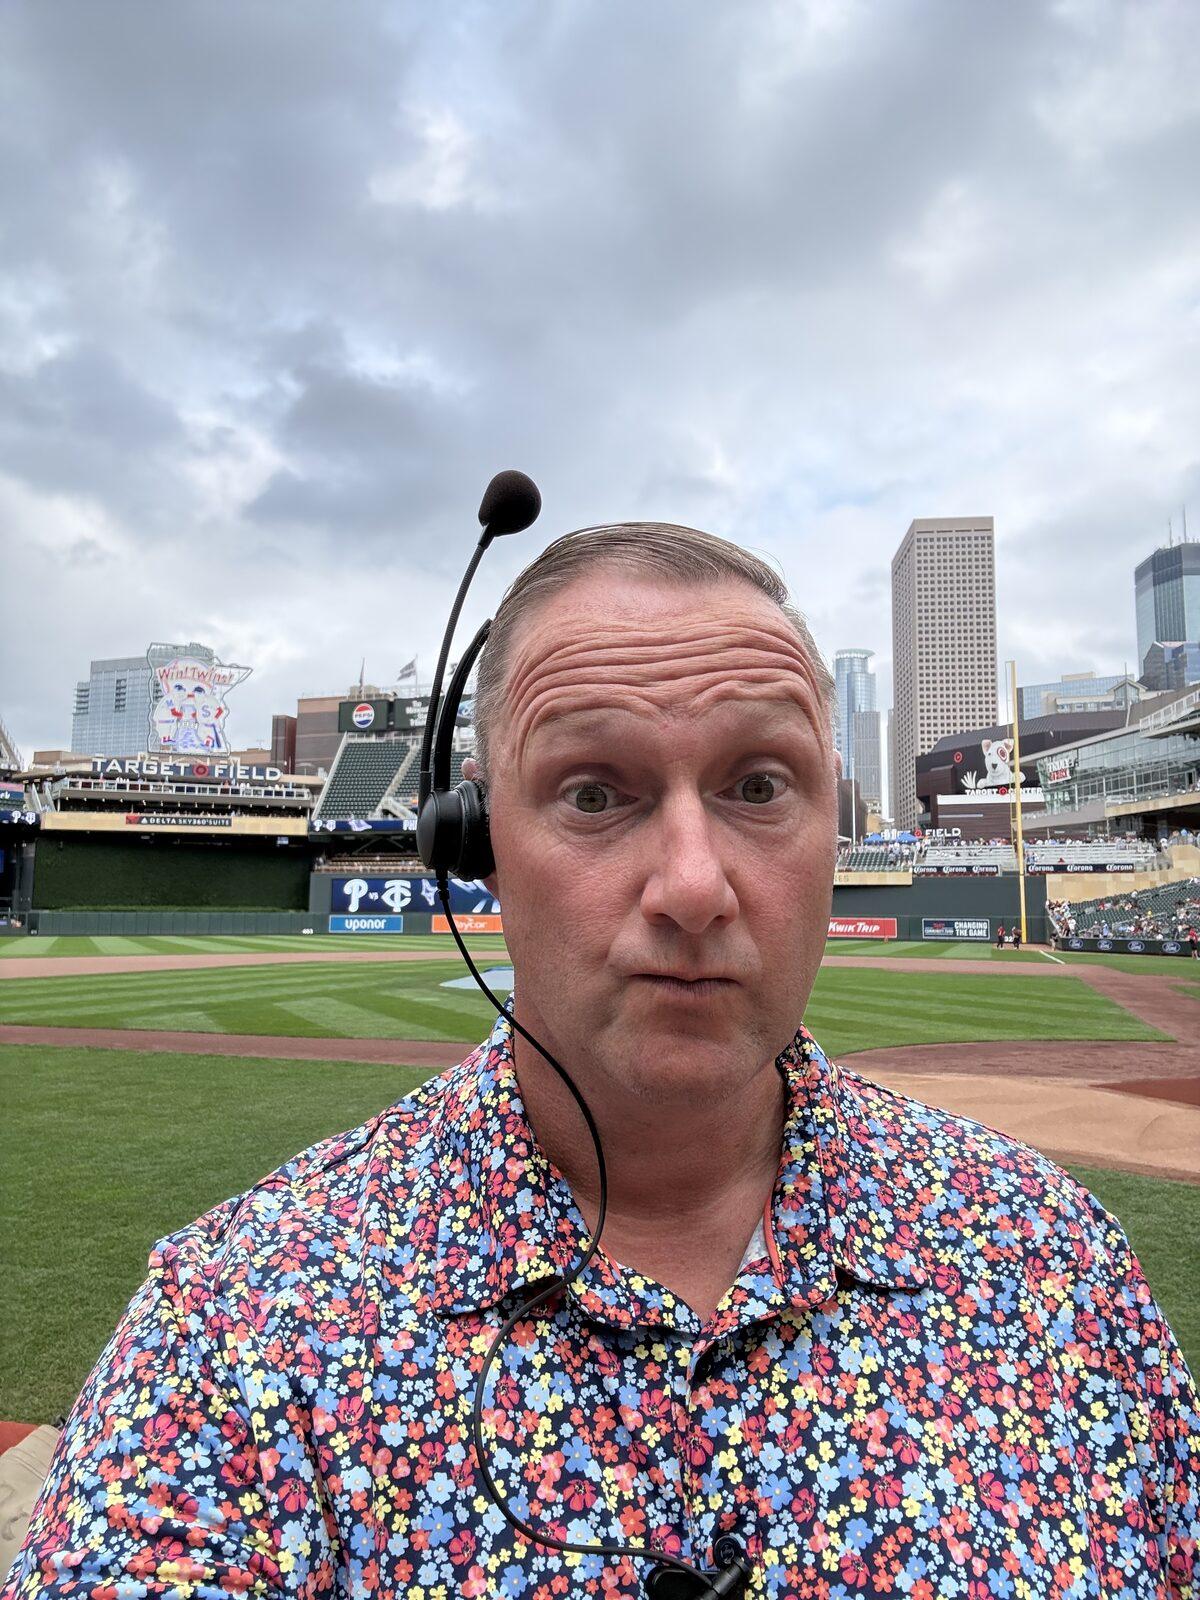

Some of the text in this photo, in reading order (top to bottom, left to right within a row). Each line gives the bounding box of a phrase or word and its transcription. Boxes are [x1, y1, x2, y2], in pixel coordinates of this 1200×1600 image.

[92, 757, 283, 781] TARGET FIELD
[1008, 787, 1043, 796] CNTER
[149, 817, 177, 825] DELTA
[925, 828, 961, 838] FIELD
[913, 865, 997, 874] Corona Corona Corona
[1028, 863, 1133, 873] Corona Corona Corona
[343, 878, 369, 913] P
[345, 918, 387, 932] uponor
[954, 921, 988, 929] CHANGING
[955, 929, 987, 937] THE GAME
